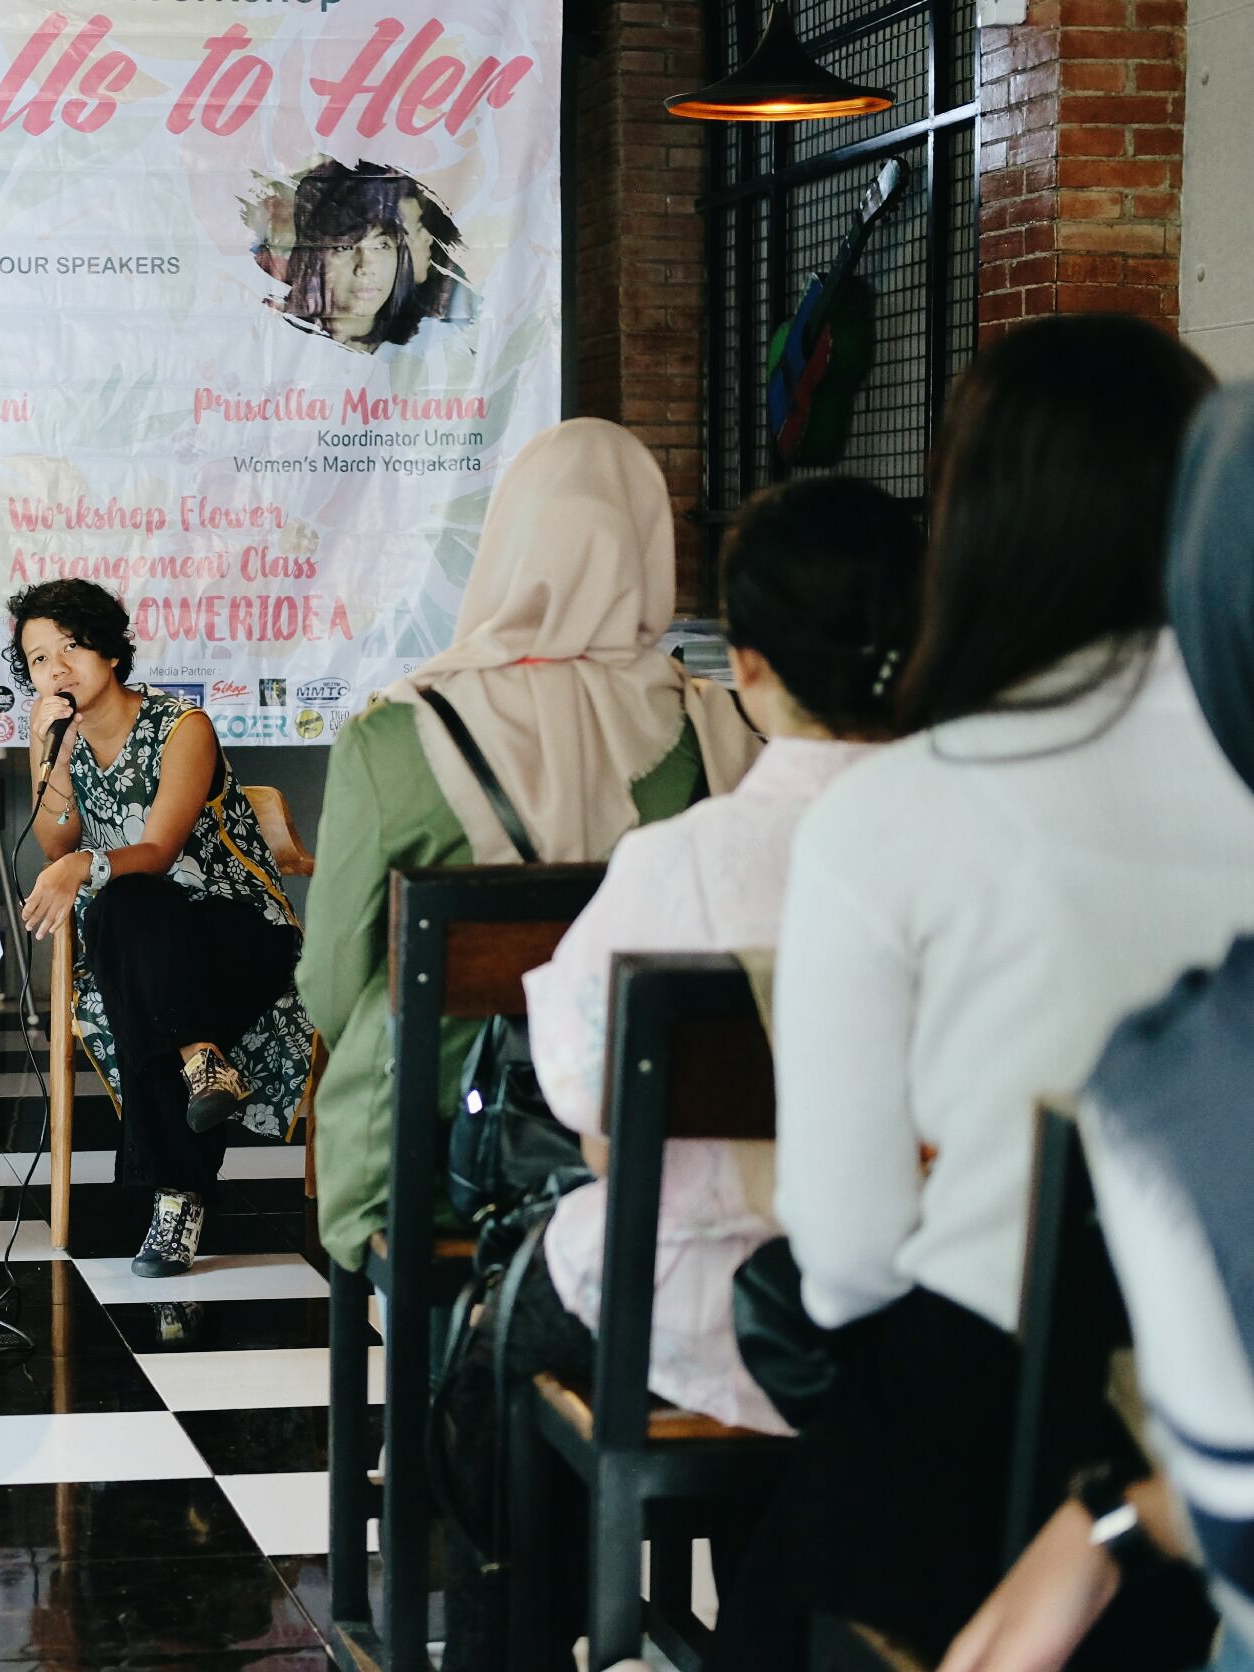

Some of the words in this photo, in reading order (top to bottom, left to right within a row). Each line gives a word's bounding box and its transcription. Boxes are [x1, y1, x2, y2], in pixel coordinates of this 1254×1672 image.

[166, 23, 273, 136] to
[309, 17, 534, 138] Her
[0, 256, 49, 274] OUR
[56, 256, 181, 274] SPEAKERS
[193, 387, 333, 425] Priscilla
[340, 386, 490, 426] Mariana
[318, 430, 420, 447] Koordinator
[425, 430, 483, 446] Umum
[324, 456, 376, 473] March
[382, 456, 481, 476] Yogyakarta
[8, 494, 167, 538] Workshop
[180, 494, 289, 532] Flower
[9, 547, 231, 594] Arrangement
[239, 545, 319, 583] Class
[149, 666, 179, 676] Media
[181, 666, 216, 676] Partner
